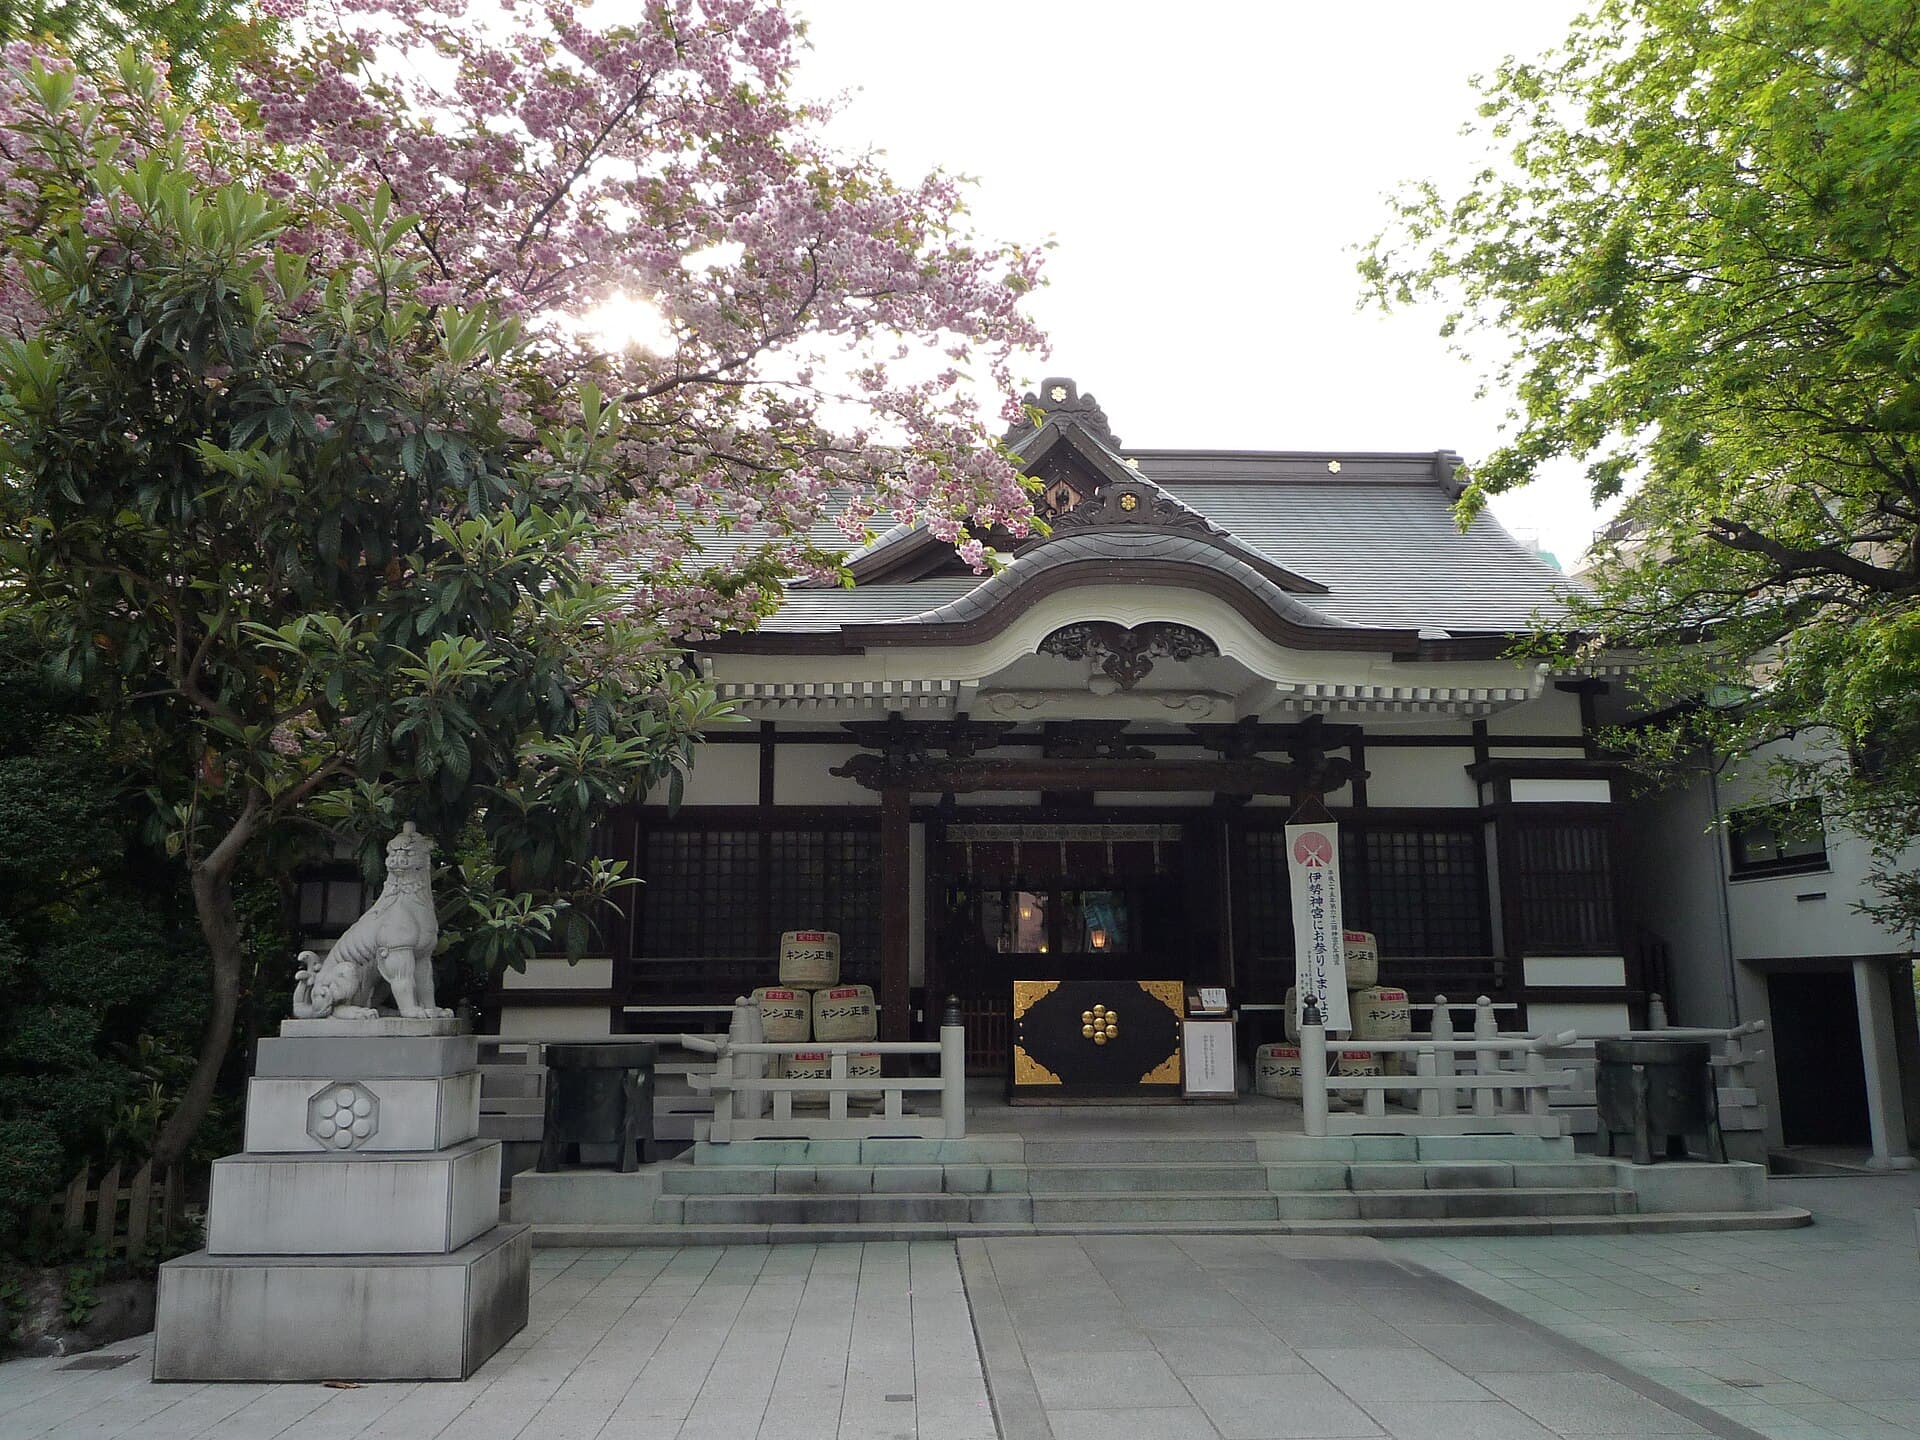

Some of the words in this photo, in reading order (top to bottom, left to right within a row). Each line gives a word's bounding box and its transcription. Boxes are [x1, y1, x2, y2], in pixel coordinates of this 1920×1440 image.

[786, 949, 834, 961] キンシ正宗
[1343, 950, 1374, 961] シ正宗
[760, 1008, 804, 1020] ンシ正宗
[820, 1006, 870, 1020] キンシ正宗
